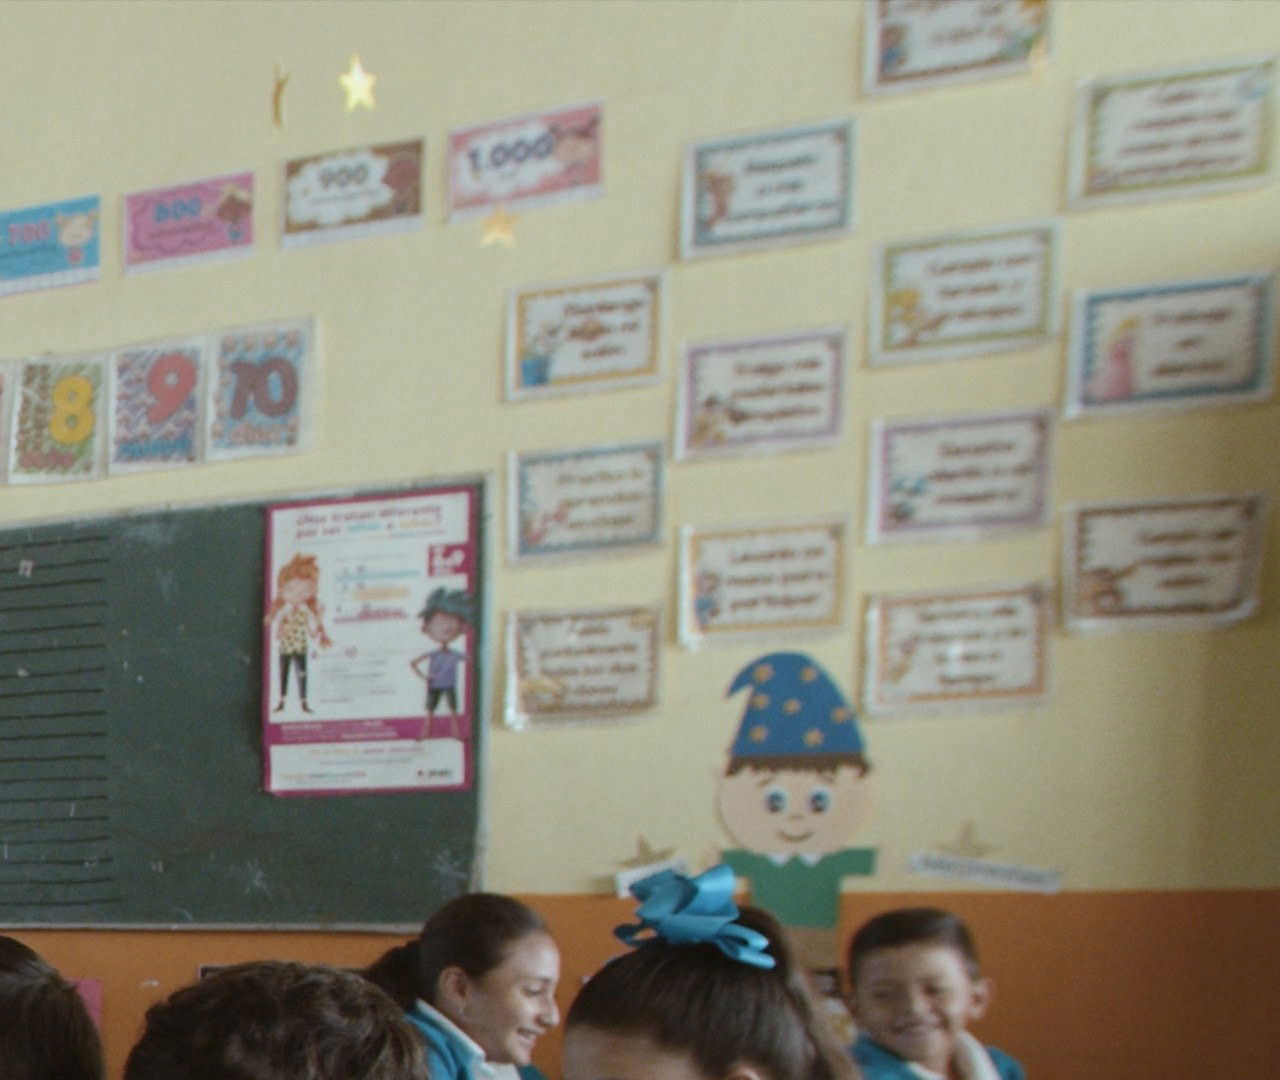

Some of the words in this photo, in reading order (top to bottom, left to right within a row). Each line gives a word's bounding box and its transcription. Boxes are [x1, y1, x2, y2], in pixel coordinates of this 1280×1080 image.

[318, 161, 370, 190] 900
[7, 221, 49, 248] 700
[50, 374, 96, 446] 8
[147, 353, 200, 424] 9
[229, 356, 300, 419] 10
